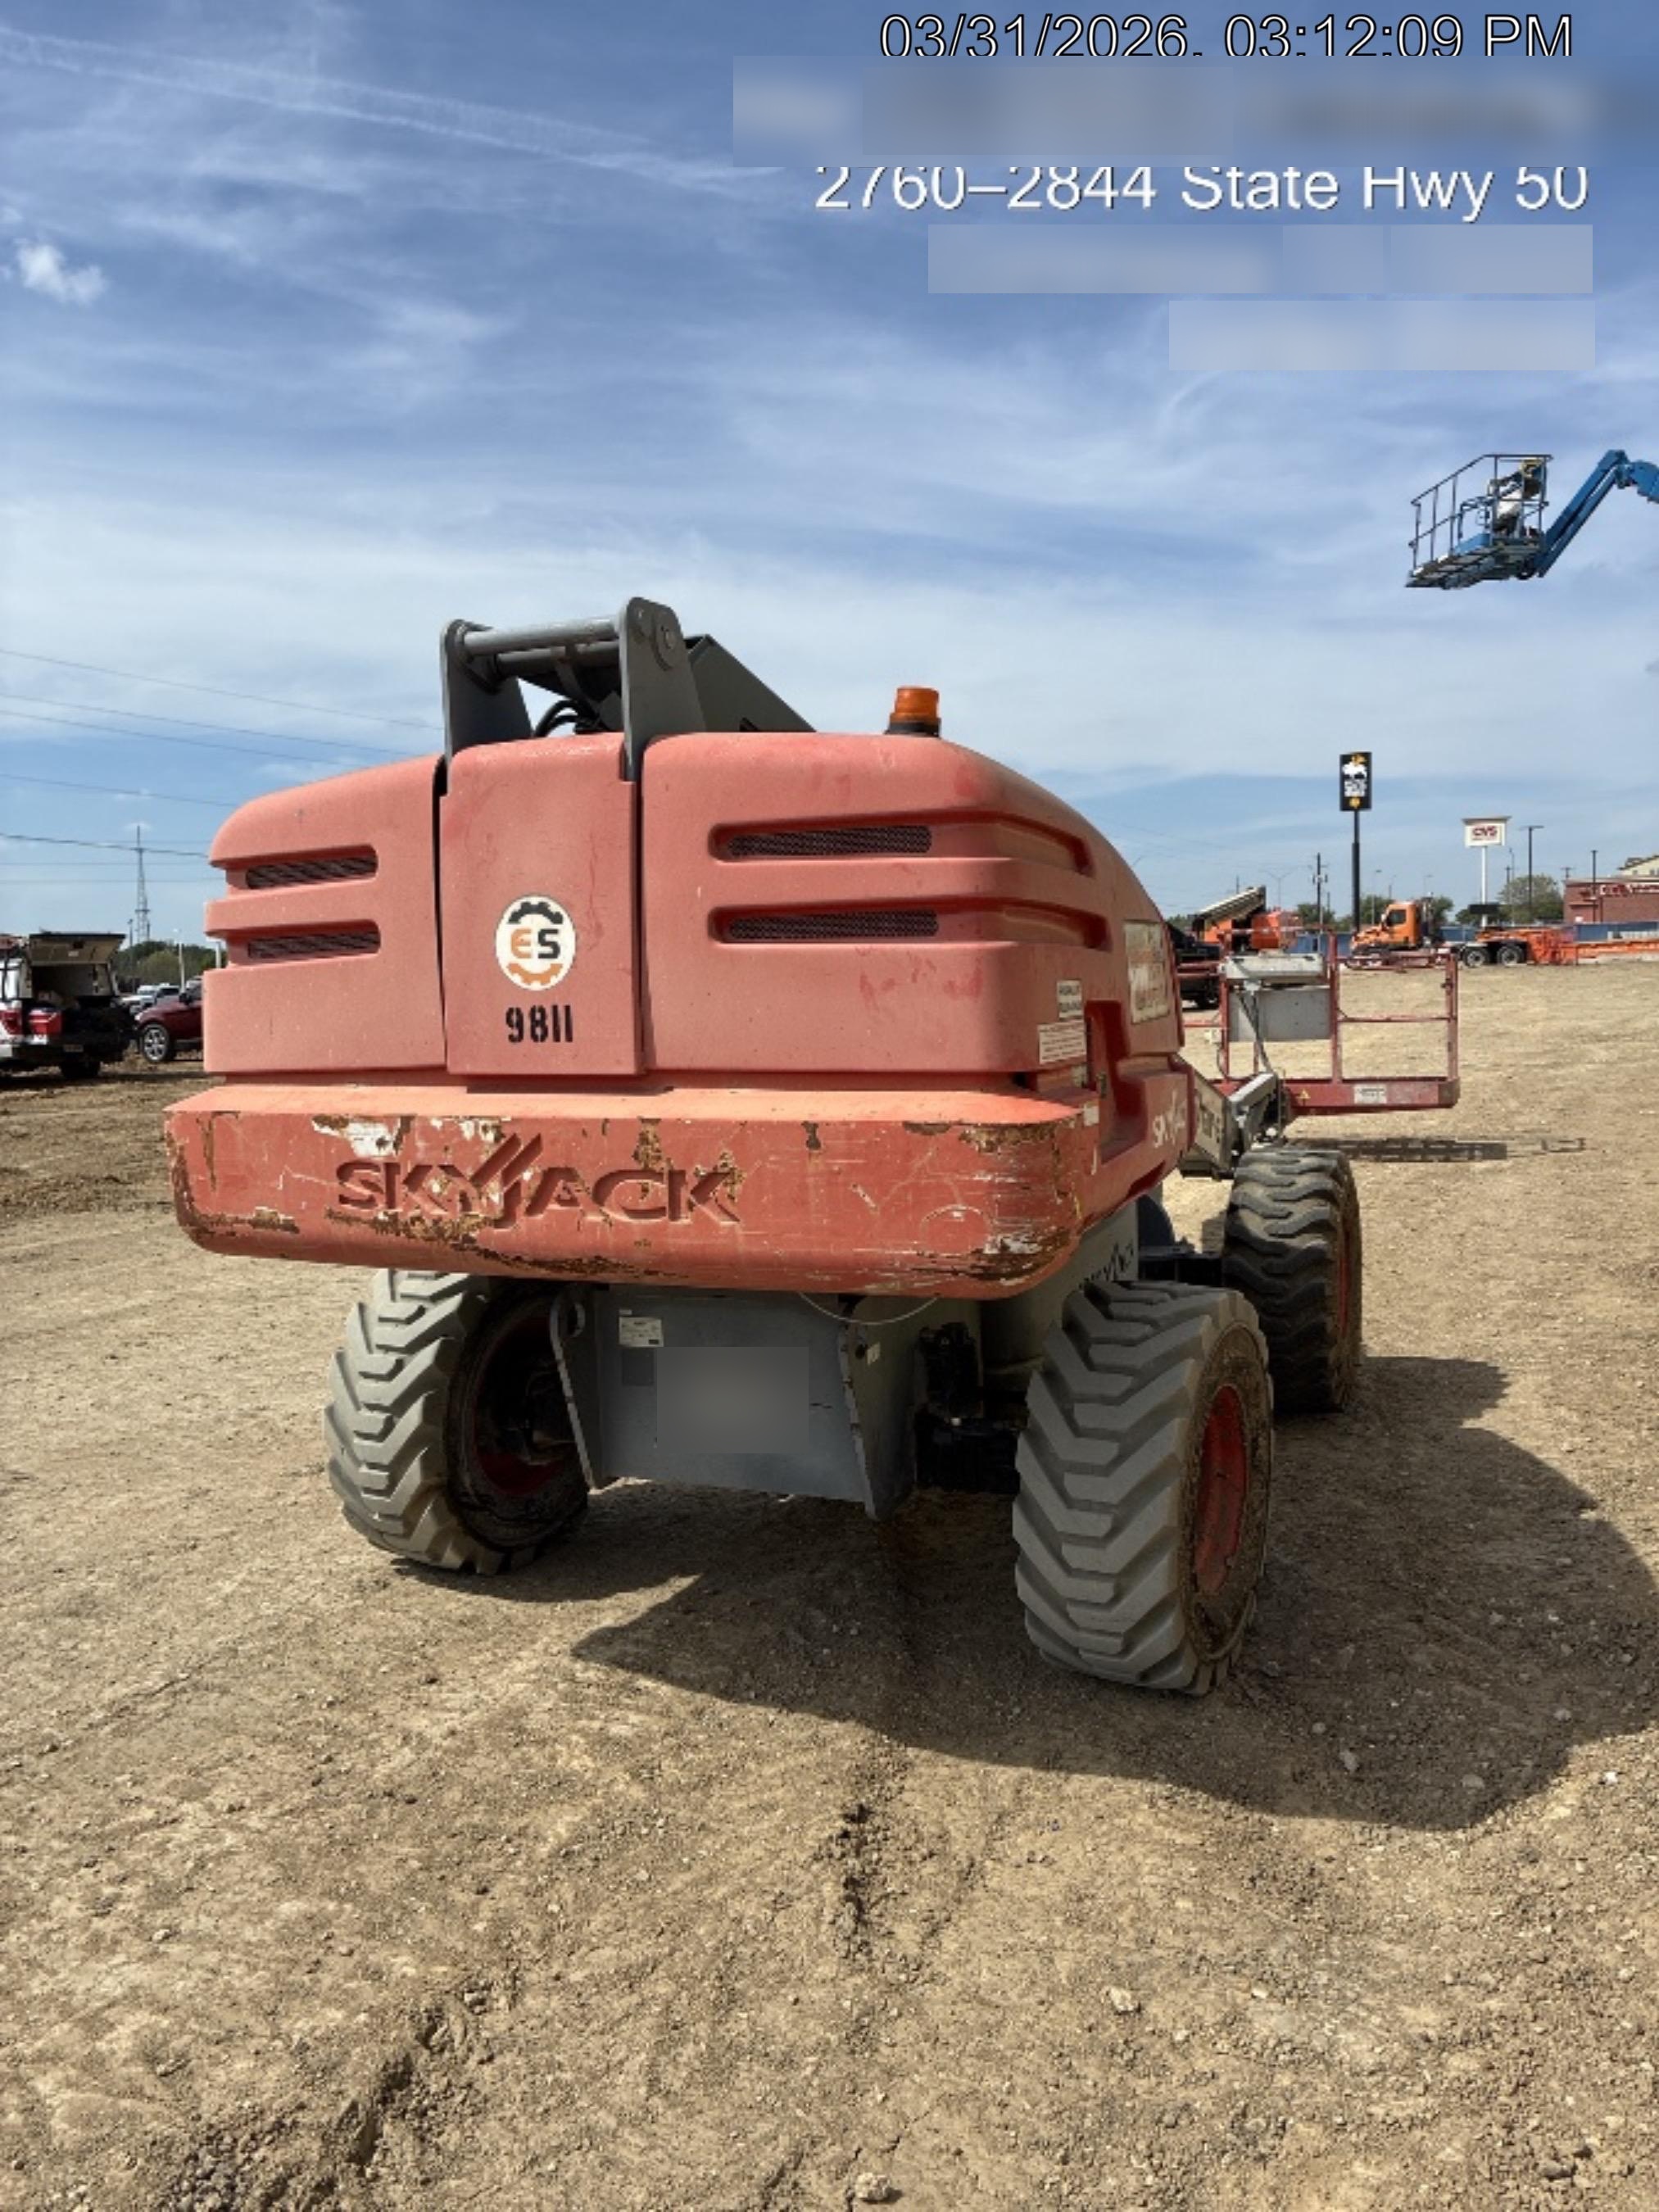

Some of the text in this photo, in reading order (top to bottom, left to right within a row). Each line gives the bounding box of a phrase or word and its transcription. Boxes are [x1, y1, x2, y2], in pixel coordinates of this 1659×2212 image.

[510, 928, 561, 959] ES
[505, 1004, 573, 1043] 9811
[336, 1133, 741, 1230] SKYJACK
